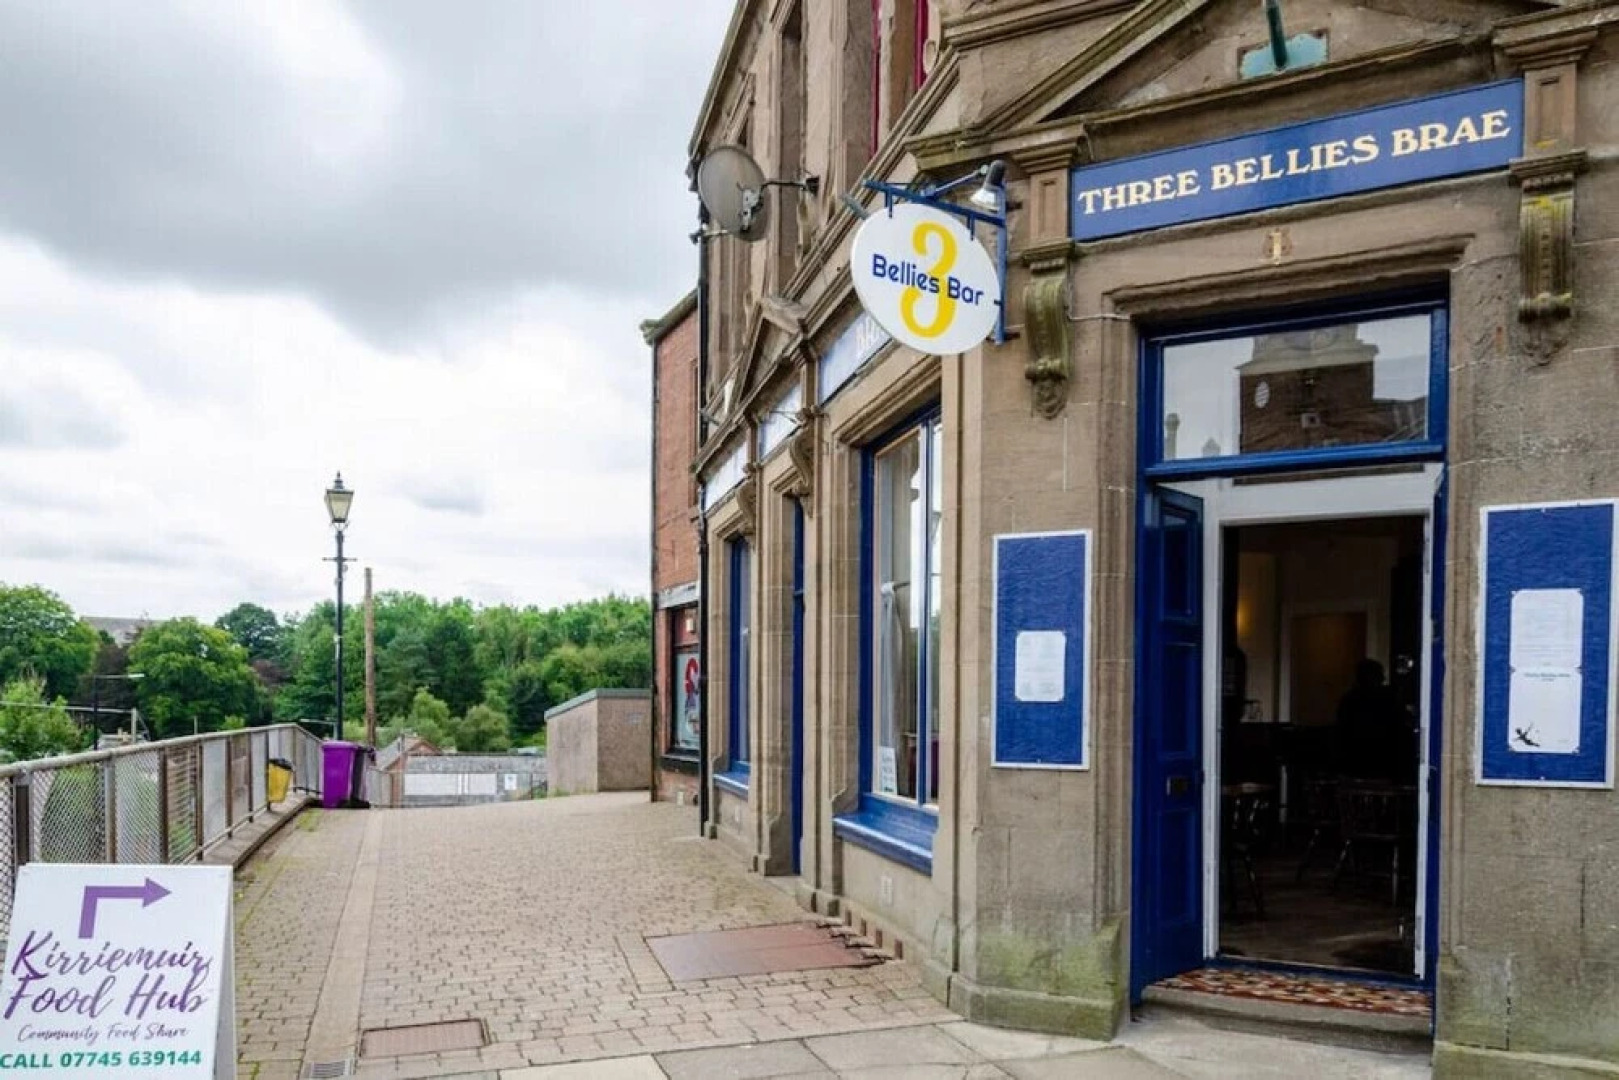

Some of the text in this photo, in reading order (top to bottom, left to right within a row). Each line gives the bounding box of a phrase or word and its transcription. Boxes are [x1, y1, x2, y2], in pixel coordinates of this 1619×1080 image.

[1078, 109, 1510, 215] THREE BELLIES BRAE
[872, 254, 984, 306] Bellies Bar
[900, 220, 958, 338] 3
[11, 931, 213, 980] Kirriemuir
[4, 970, 208, 1020] Food Hub
[18, 1022, 189, 1045] Community Food Share
[0, 1050, 201, 1069] CALL 07745 639144
